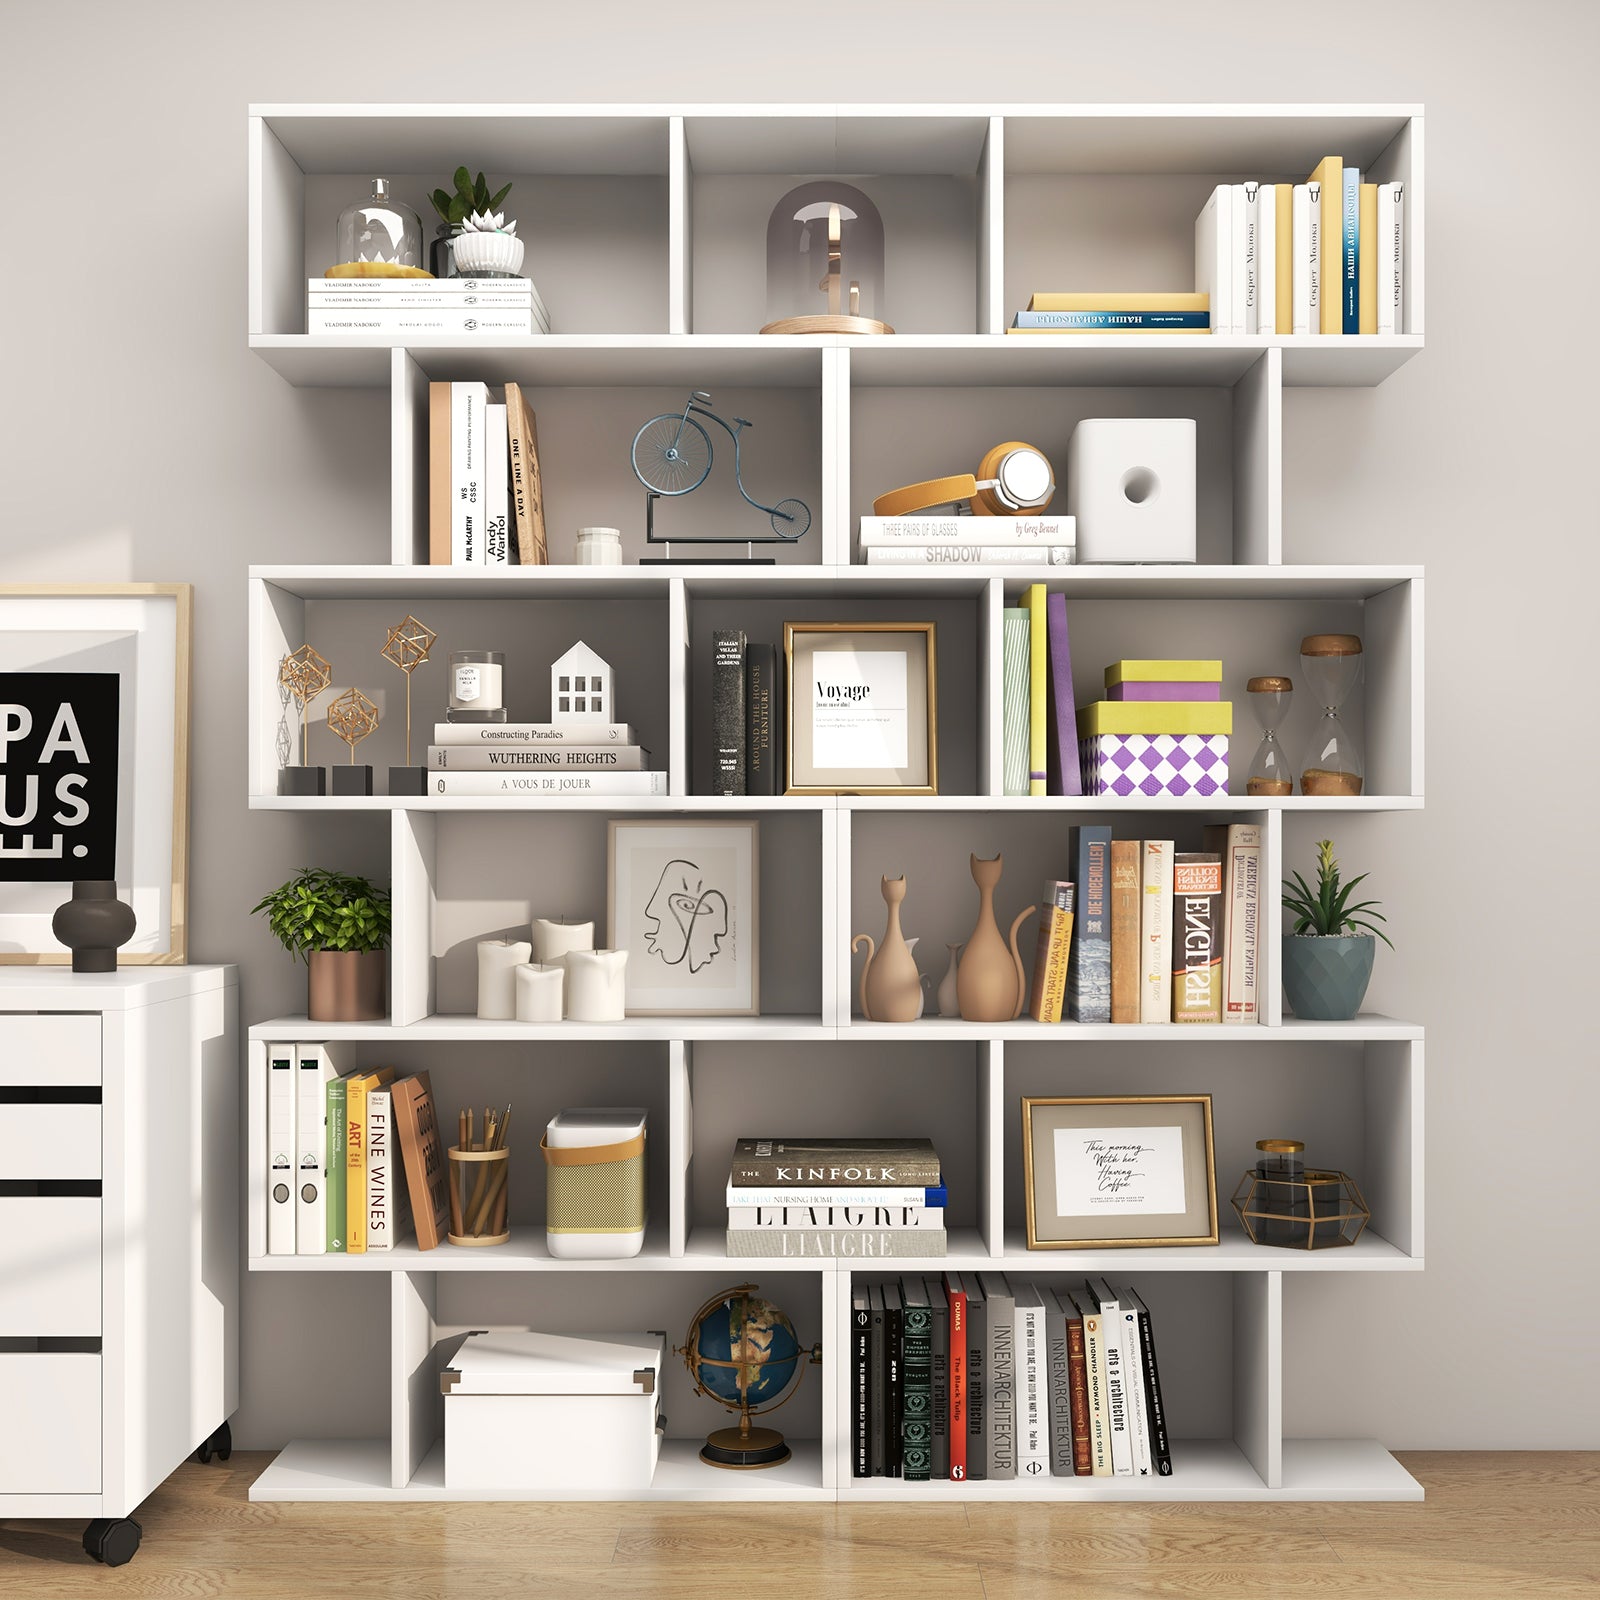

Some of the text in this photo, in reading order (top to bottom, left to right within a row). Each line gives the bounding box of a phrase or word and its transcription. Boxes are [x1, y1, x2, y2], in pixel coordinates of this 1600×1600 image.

[1246, 223, 1254, 307] Секрет Молока
[1309, 223, 1318, 307] Секрет Молока
[1347, 249, 1355, 280] НАШИ
[514, 463, 522, 484] LINE
[461, 488, 467, 499] WS
[487, 521, 498, 556] Andy
[497, 516, 505, 561] Warhol
[882, 523, 958, 536] THREE PAIRS OF GLASSES
[1015, 522, 1023, 537] by
[1024, 522, 1038, 537] Greg
[927, 547, 982, 563] SHADOW
[817, 681, 870, 701] Voyage
[752, 665, 760, 772] AROUND THE HOUSE
[761, 688, 769, 748] FURNITURE
[0, 702, 90, 763] PA
[481, 729, 563, 740] Constructing Paradies
[488, 753, 617, 764] WUTHERING HEIGHTS
[501, 779, 591, 791] A VOUS DE JOUER
[349, 1121, 361, 1148] ART
[371, 1115, 385, 1157] FINE
[1083, 1140, 1155, 1156] This morning
[1093, 1151, 1120, 1167] With
[776, 1168, 896, 1180] KINFOLK
[1098, 1164, 1145, 1181] Having
[1098, 1176, 1129, 1192] Coffee
[371, 1166, 385, 1230] WINES
[783, 1234, 893, 1256] LIAIGRE
[1090, 1337, 1098, 1373] CHANDLER
[1128, 1328, 1136, 1360] ESSENTIALS
[935, 1354, 944, 1371] arts
[970, 1350, 981, 1367] arts
[1108, 1349, 1118, 1366] arts
[1130, 1360, 1137, 1369] OF
[935, 1384, 947, 1436] architecture
[970, 1381, 983, 1435] architecture
[993, 1325, 1011, 1471] INNENARCHITEKTUR
[1052, 1338, 1071, 1468] INNENARCHITEKTUR
[1111, 1380, 1124, 1432] architecture
[1133, 1389, 1143, 1435] COMMUNICATION
